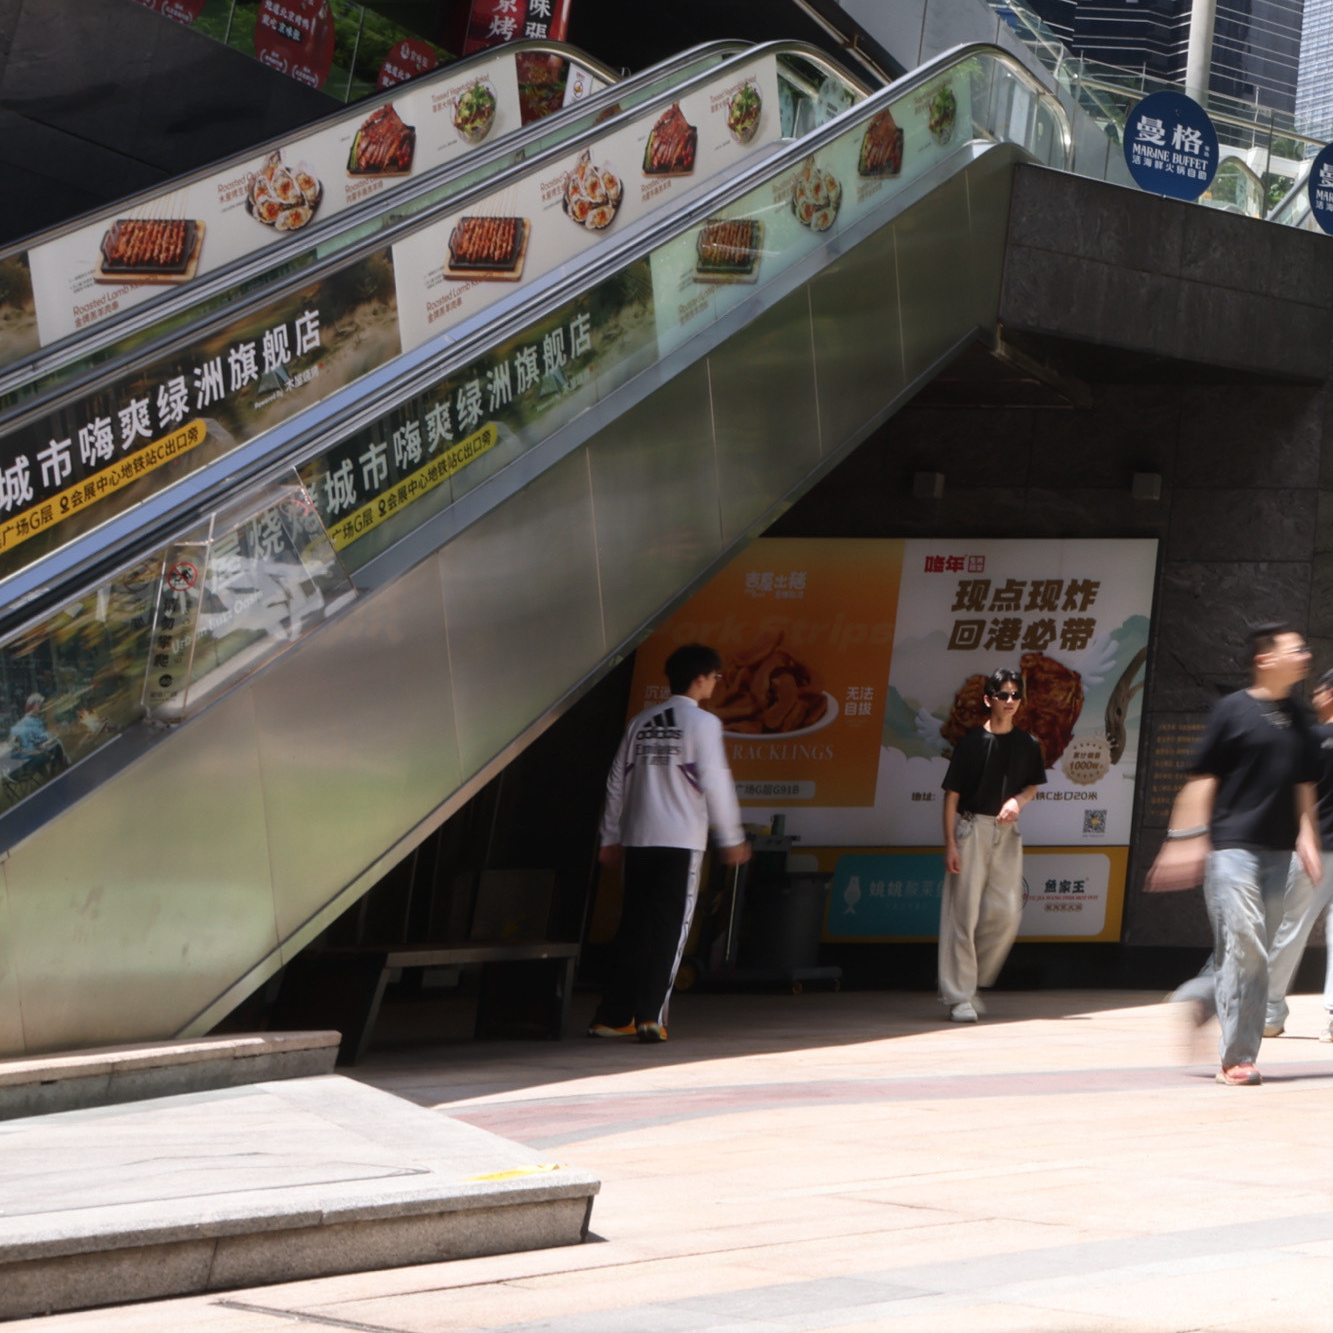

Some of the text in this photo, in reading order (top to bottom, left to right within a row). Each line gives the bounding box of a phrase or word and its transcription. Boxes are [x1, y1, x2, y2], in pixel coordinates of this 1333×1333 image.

[1135, 115, 1203, 155] 曼格
[1132, 142, 1208, 171] MARINE BUFFET
[73, 296, 107, 317] Roasted
[426, 293, 453, 314] Roasted
[0, 310, 321, 512] 城市嗨爽绿洲旗舰店
[324, 312, 592, 514] 城市嗨爽绿洲旗舰店
[70, 426, 199, 509] 会展中心地铁站C出口旁
[387, 429, 492, 509] 会展中心地铁站C出口旁
[951, 579, 1101, 612] 现点现炸
[947, 618, 1096, 652] 回港必带
[844, 702, 872, 716] 自拔
[846, 686, 874, 701] 无法
[636, 727, 683, 741] adidas
